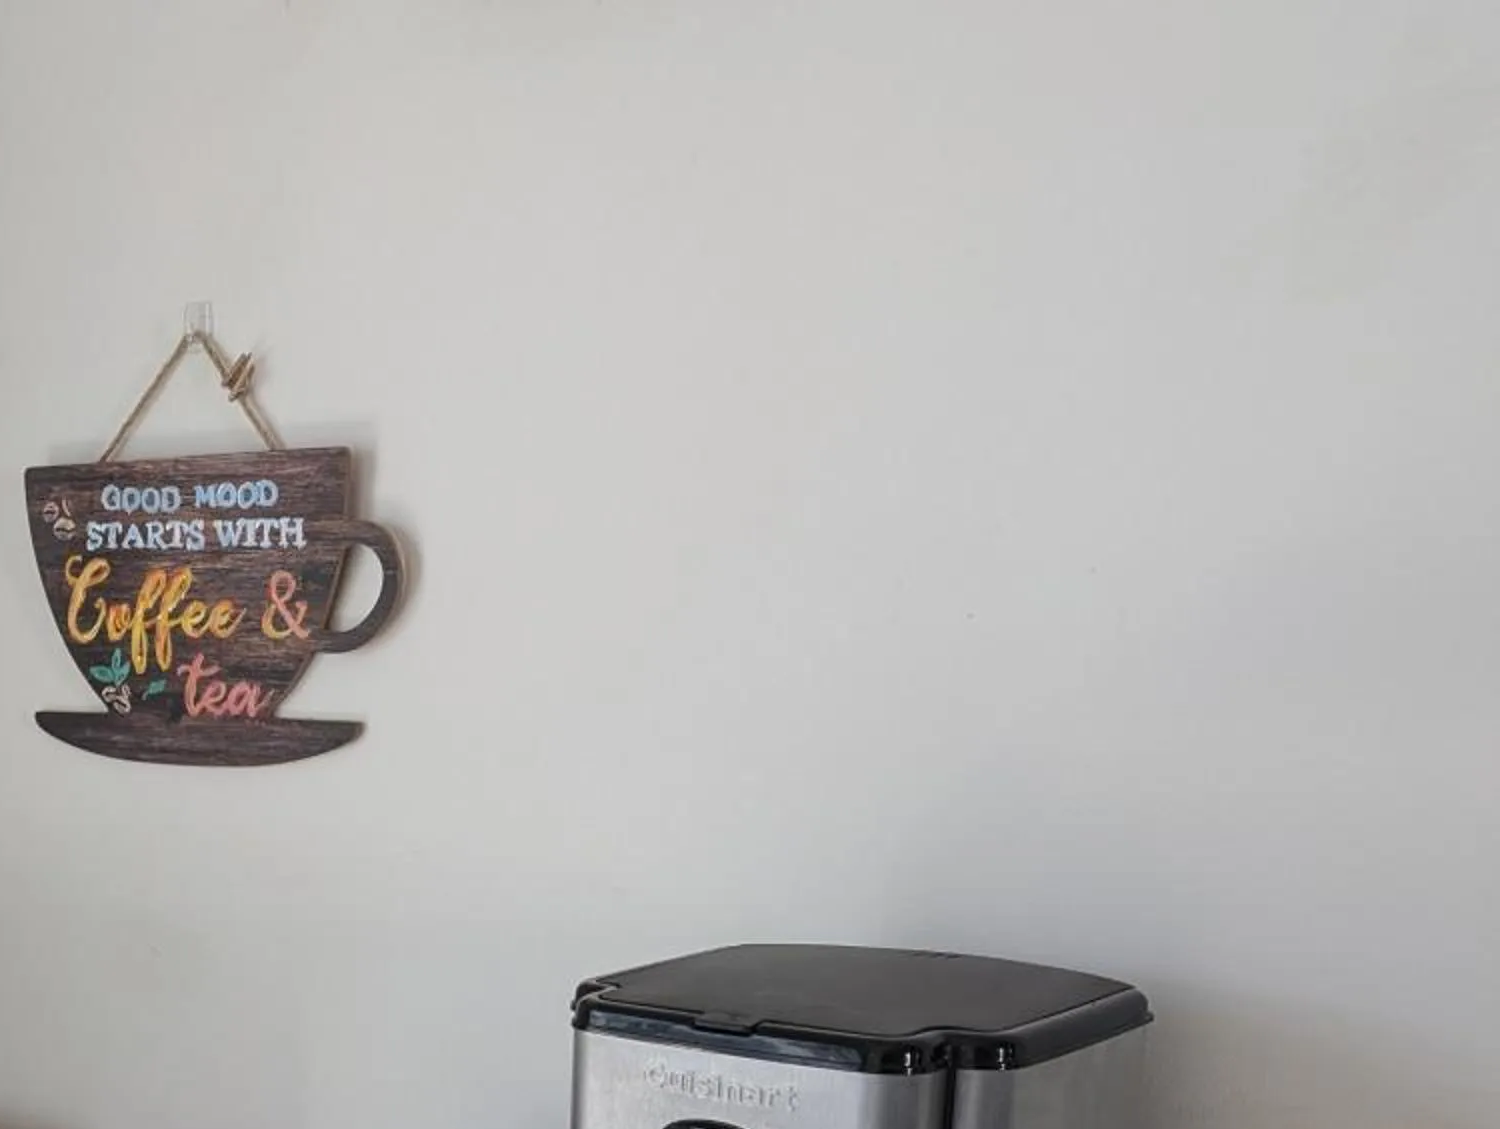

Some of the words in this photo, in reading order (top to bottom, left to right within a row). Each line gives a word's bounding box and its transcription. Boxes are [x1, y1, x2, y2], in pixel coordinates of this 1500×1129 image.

[101, 484, 181, 514] GOOD
[195, 479, 279, 508] MOOD
[86, 518, 205, 551] STARTS
[212, 516, 307, 549] WITH
[65, 555, 246, 674] Coffee
[261, 569, 311, 639] &
[177, 651, 270, 718] tea
